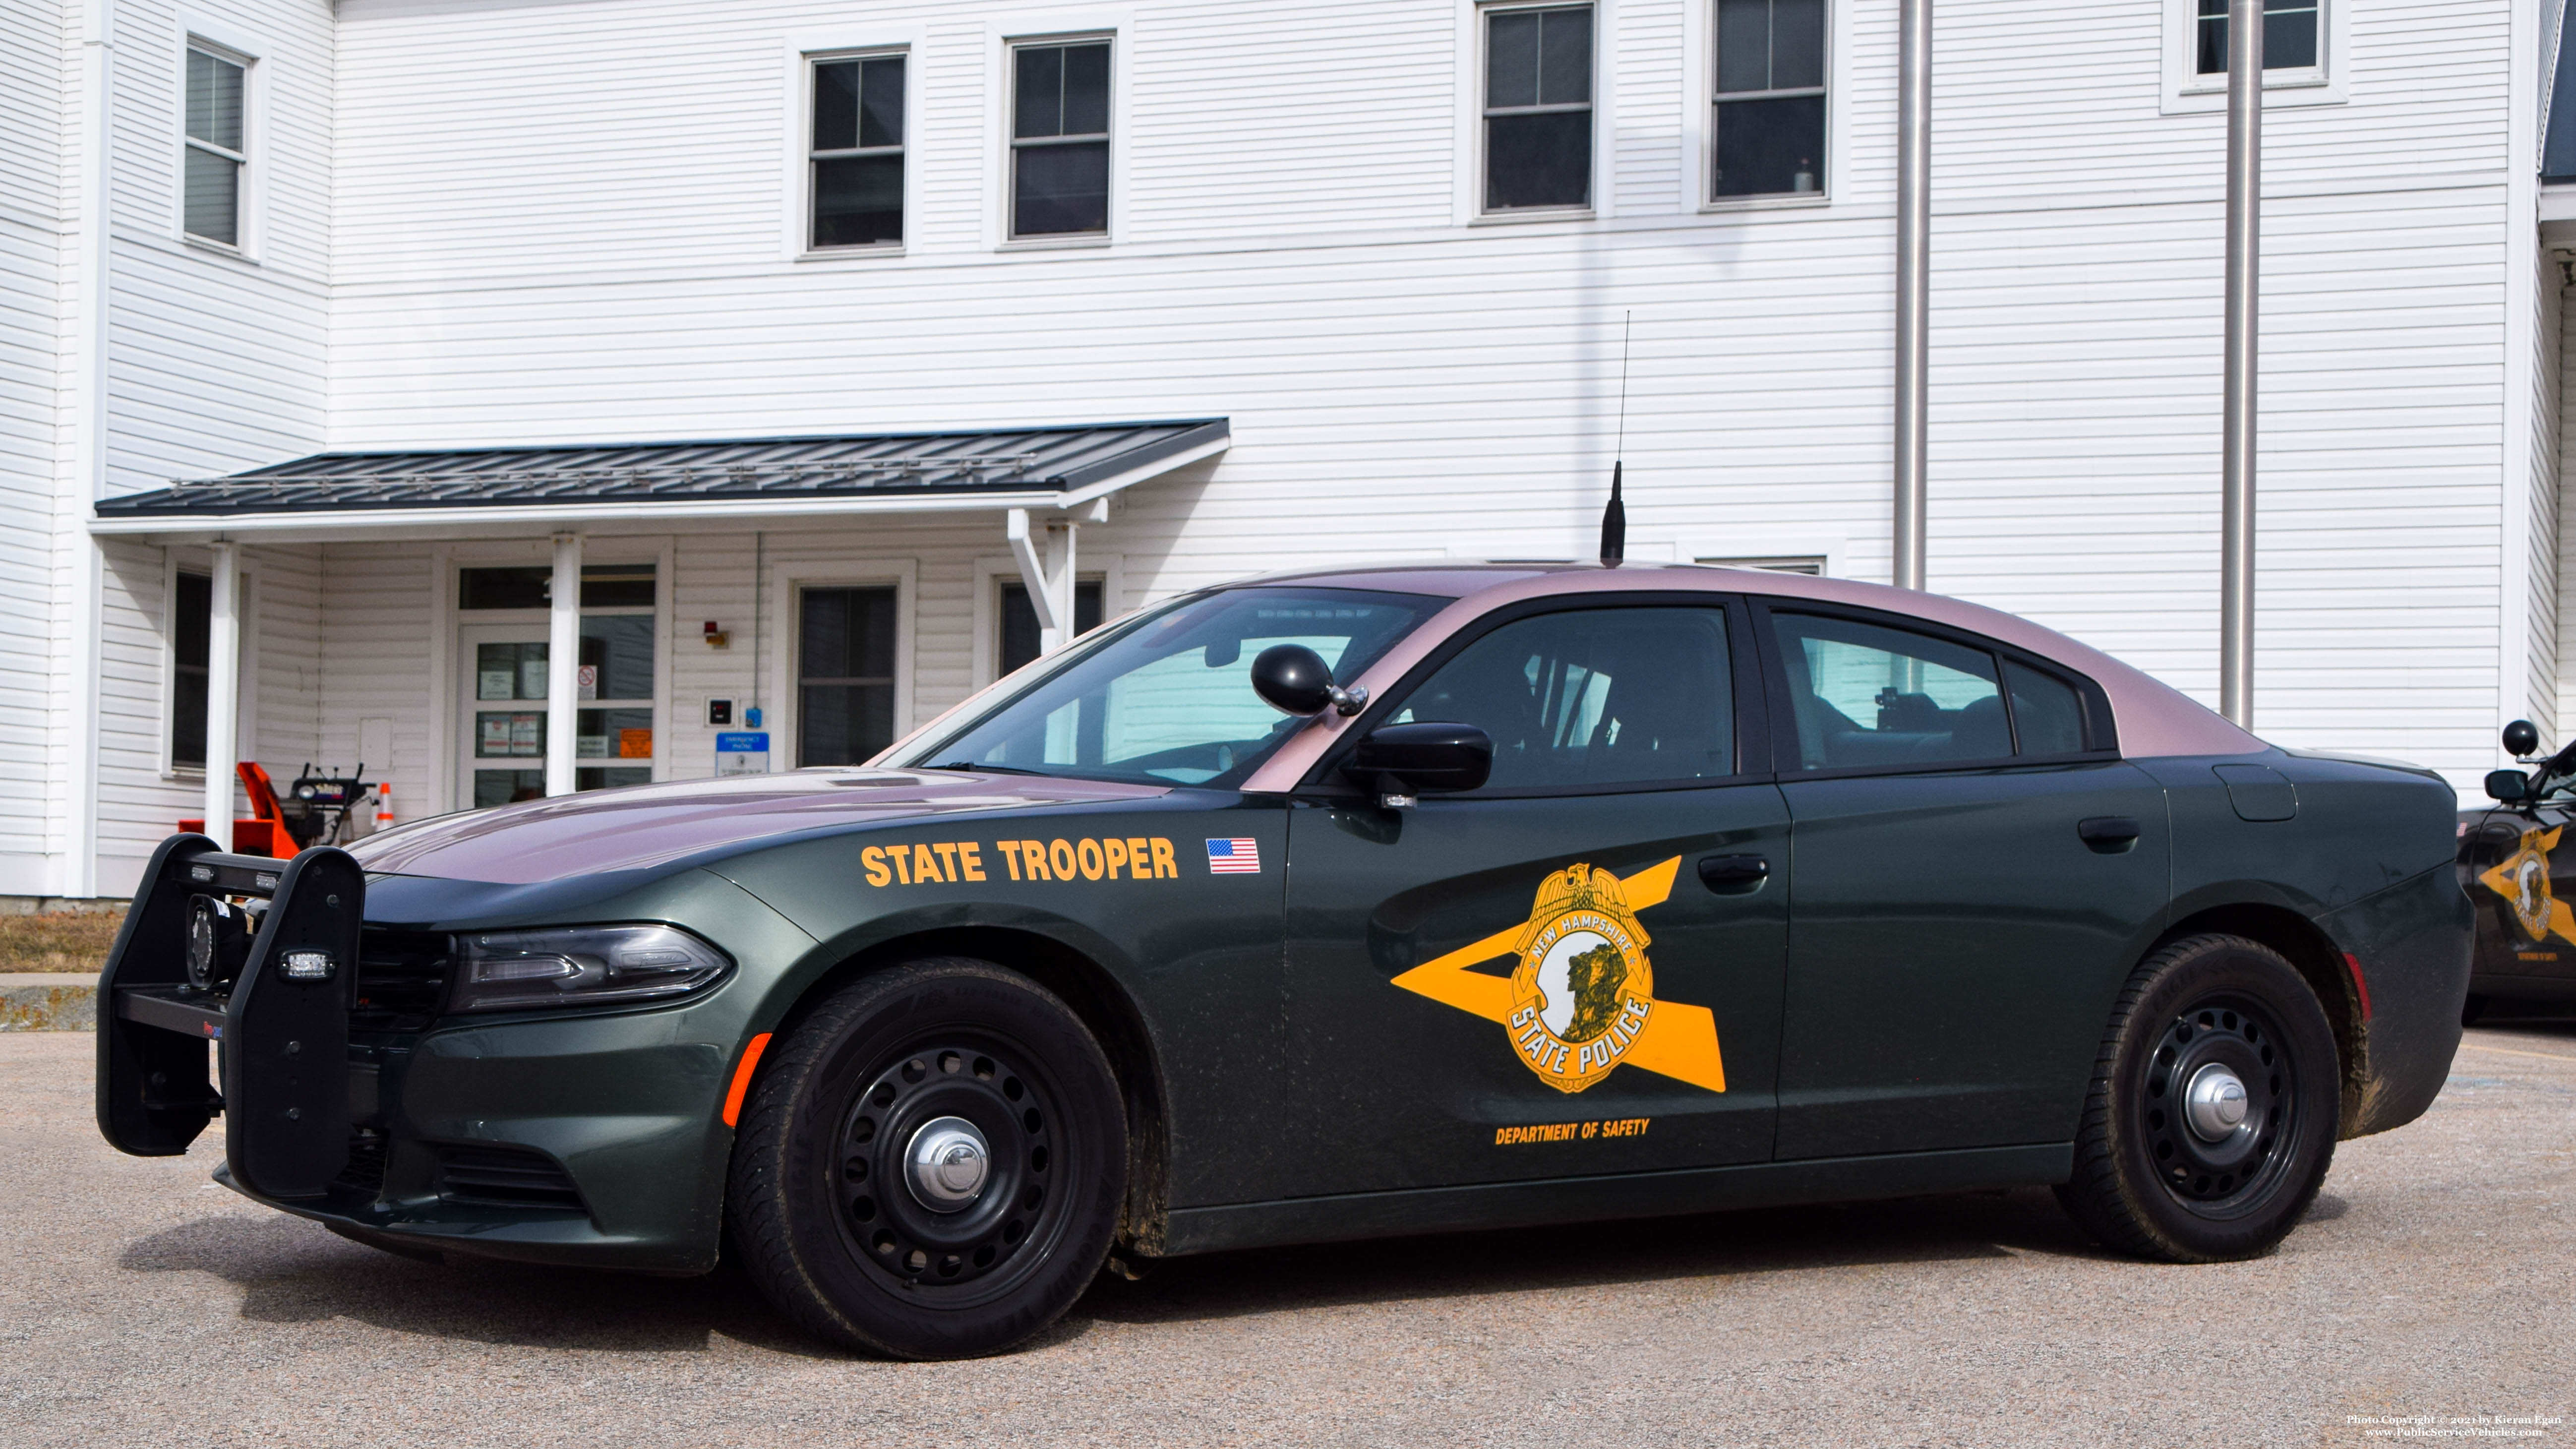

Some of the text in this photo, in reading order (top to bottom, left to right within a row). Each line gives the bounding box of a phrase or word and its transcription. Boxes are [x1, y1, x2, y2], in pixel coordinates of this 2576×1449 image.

[861, 837, 1178, 887] STATE TROOPER
[1532, 915, 1632, 958] NEW HAMPSHIRE
[1511, 997, 1651, 1074] STATE POLICE
[1495, 1118, 1650, 1145] DEPARTMENT OF SAFETY
